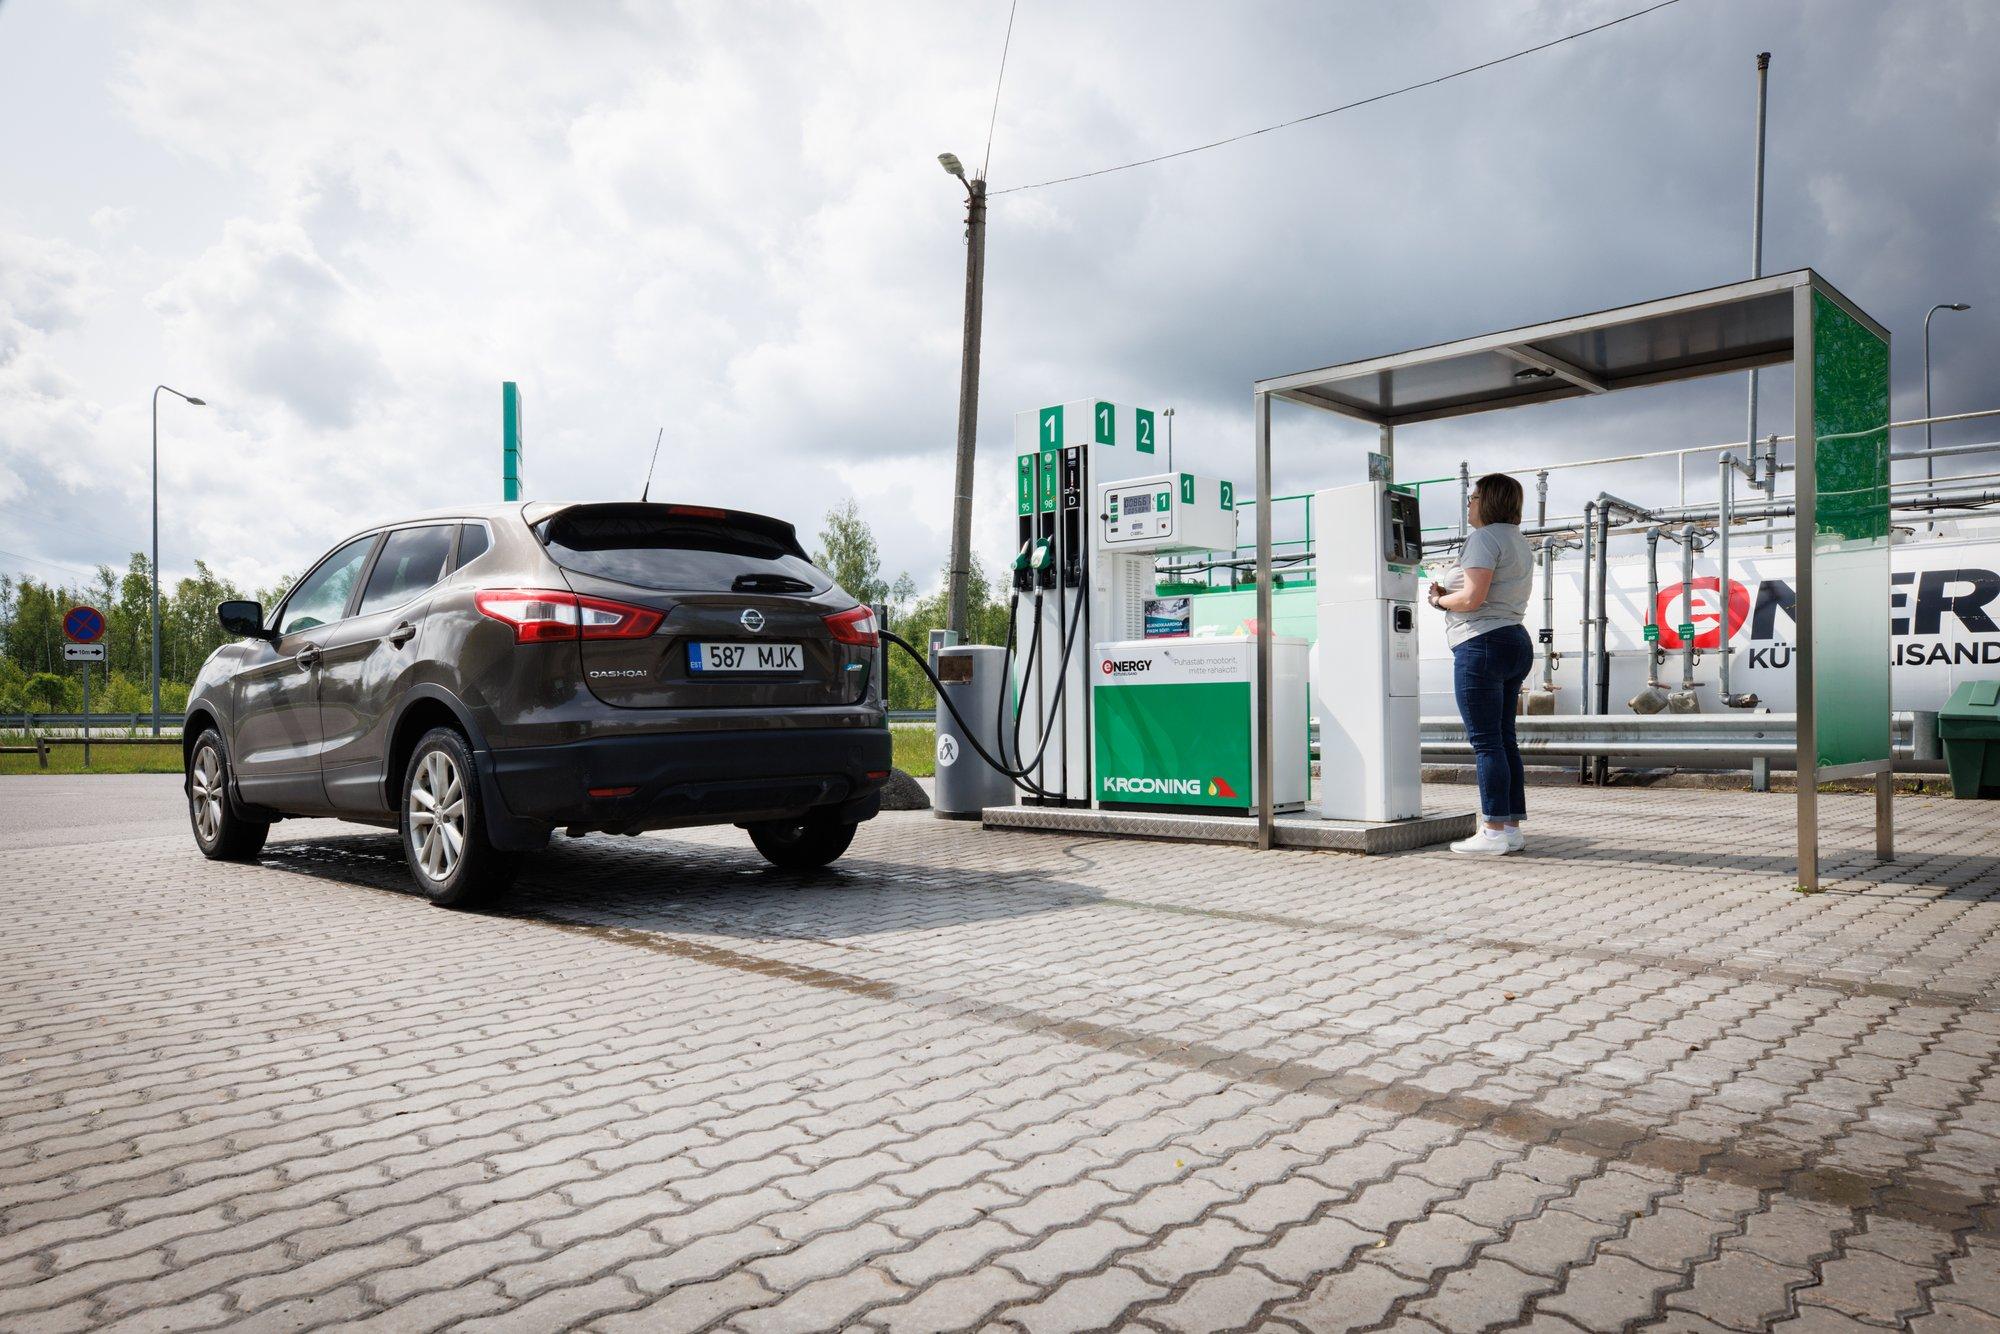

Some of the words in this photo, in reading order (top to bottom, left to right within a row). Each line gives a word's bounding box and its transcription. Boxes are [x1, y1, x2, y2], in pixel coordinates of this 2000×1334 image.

[1044, 414, 1056, 443] 1
[1099, 408, 1110, 437] 1
[1139, 418, 1151, 445] 2
[1183, 479, 1192, 498] 1
[1068, 496, 1076, 506] D
[1160, 495, 1167, 508] 1
[1222, 485, 1231, 507] 2
[1021, 503, 1030, 512] 95
[1044, 499, 1053, 509] 98
[710, 646, 745, 668] 587
[758, 646, 797, 668] MJK
[1174, 658, 1205, 666] Puhastab
[690, 661, 702, 669] EST
[1207, 666, 1238, 674] rahakotti
[589, 670, 647, 678] QASHQAI
[1103, 776, 1201, 796] KROONING
